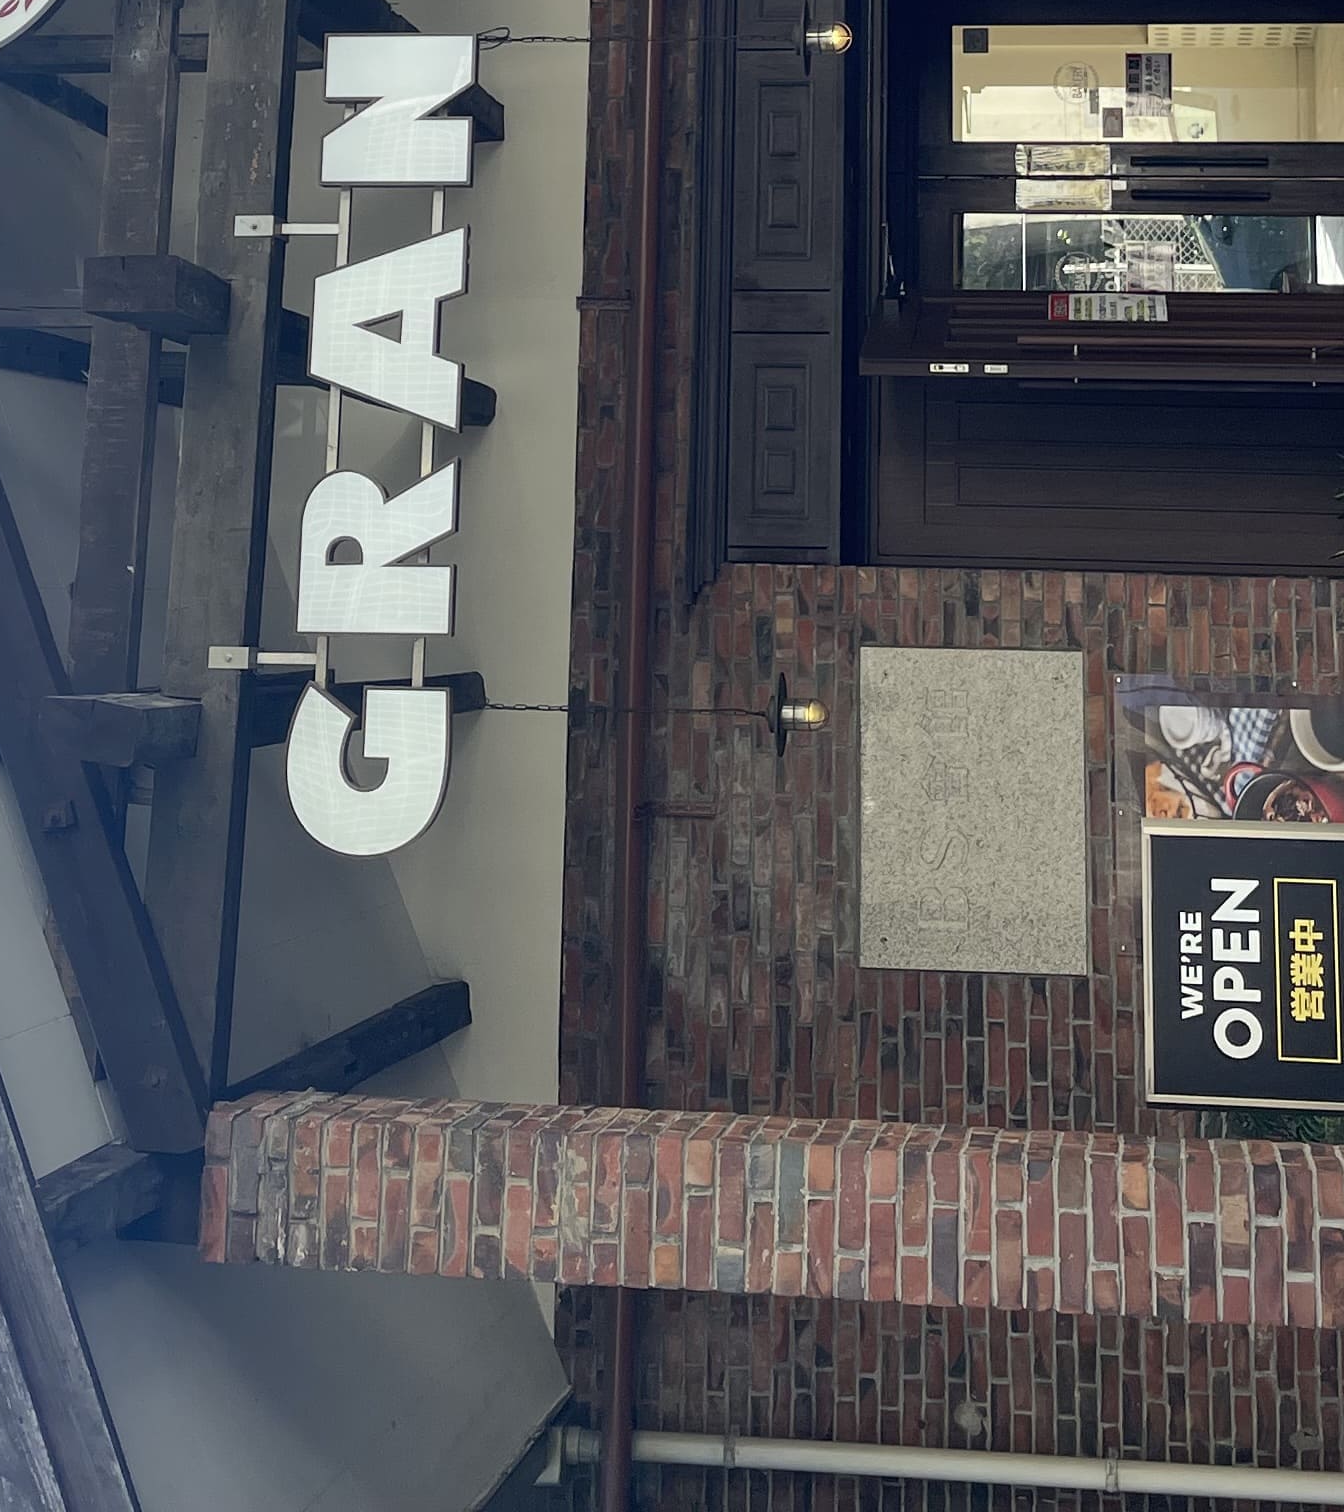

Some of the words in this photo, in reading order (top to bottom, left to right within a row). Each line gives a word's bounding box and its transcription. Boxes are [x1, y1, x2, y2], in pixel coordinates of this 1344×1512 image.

[285, 32, 477, 857] GRAN
[1210, 877, 1263, 1059] OPEN
[1288, 918, 1325, 1022] 営業中
